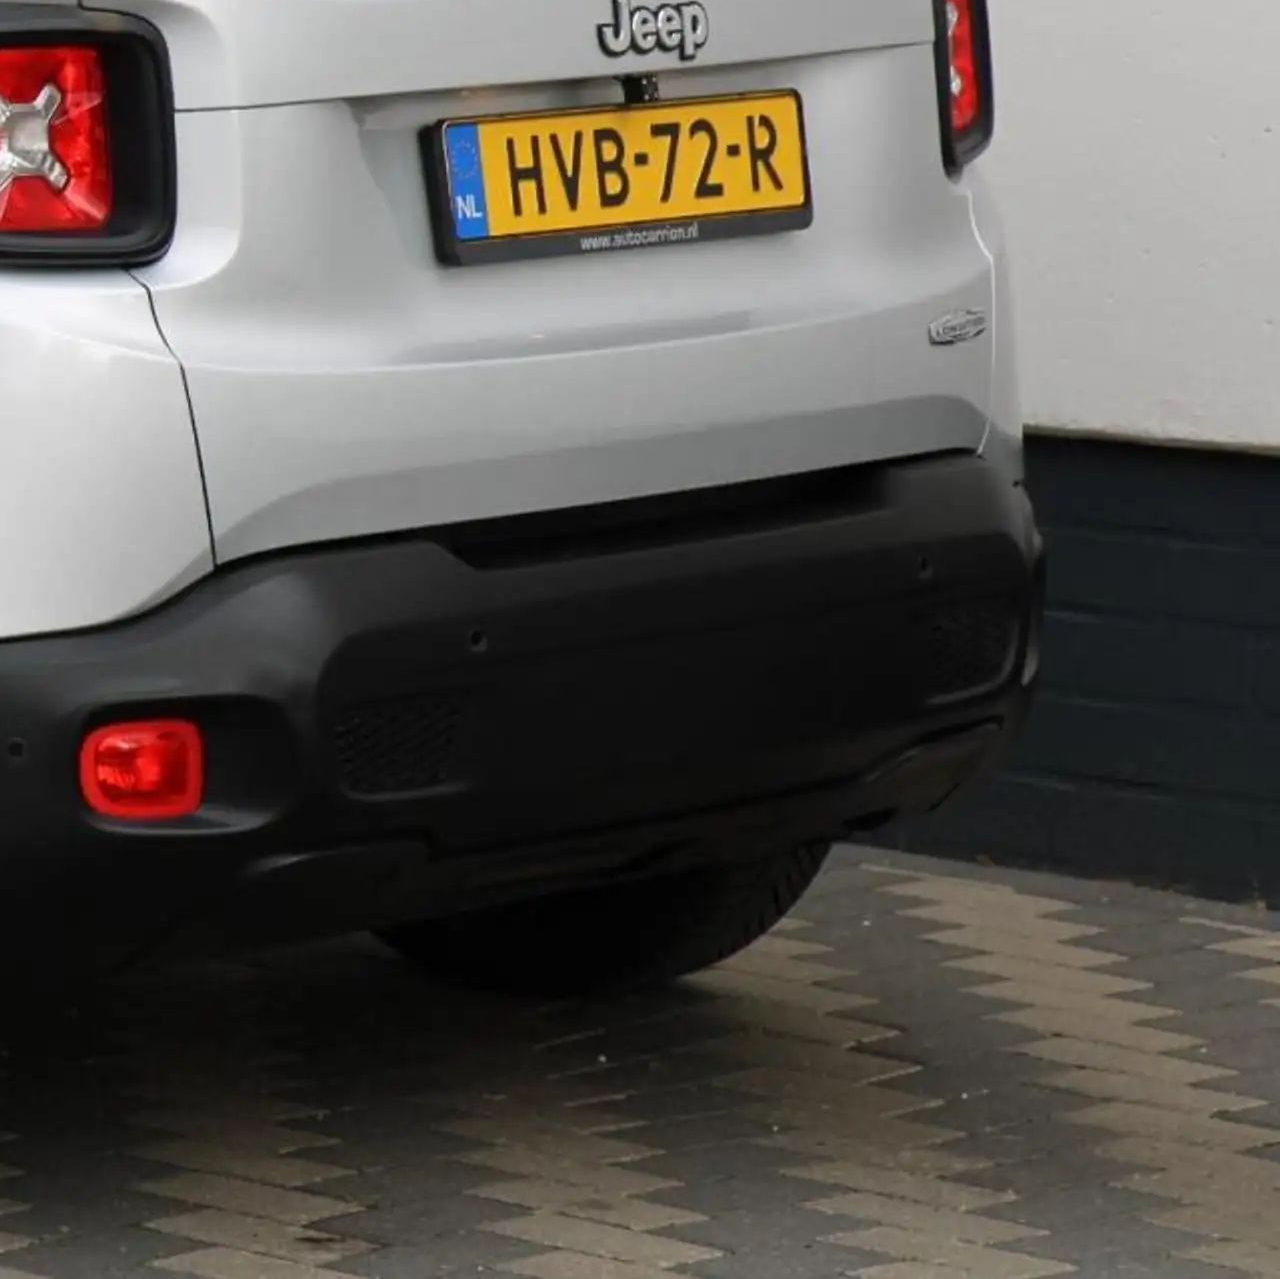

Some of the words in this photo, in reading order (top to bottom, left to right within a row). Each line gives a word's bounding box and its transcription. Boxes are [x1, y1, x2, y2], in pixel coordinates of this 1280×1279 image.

[506, 114, 785, 217] HVB-72-R
[455, 193, 483, 220] NL
[579, 221, 699, 251] www.autocarrion.nl
